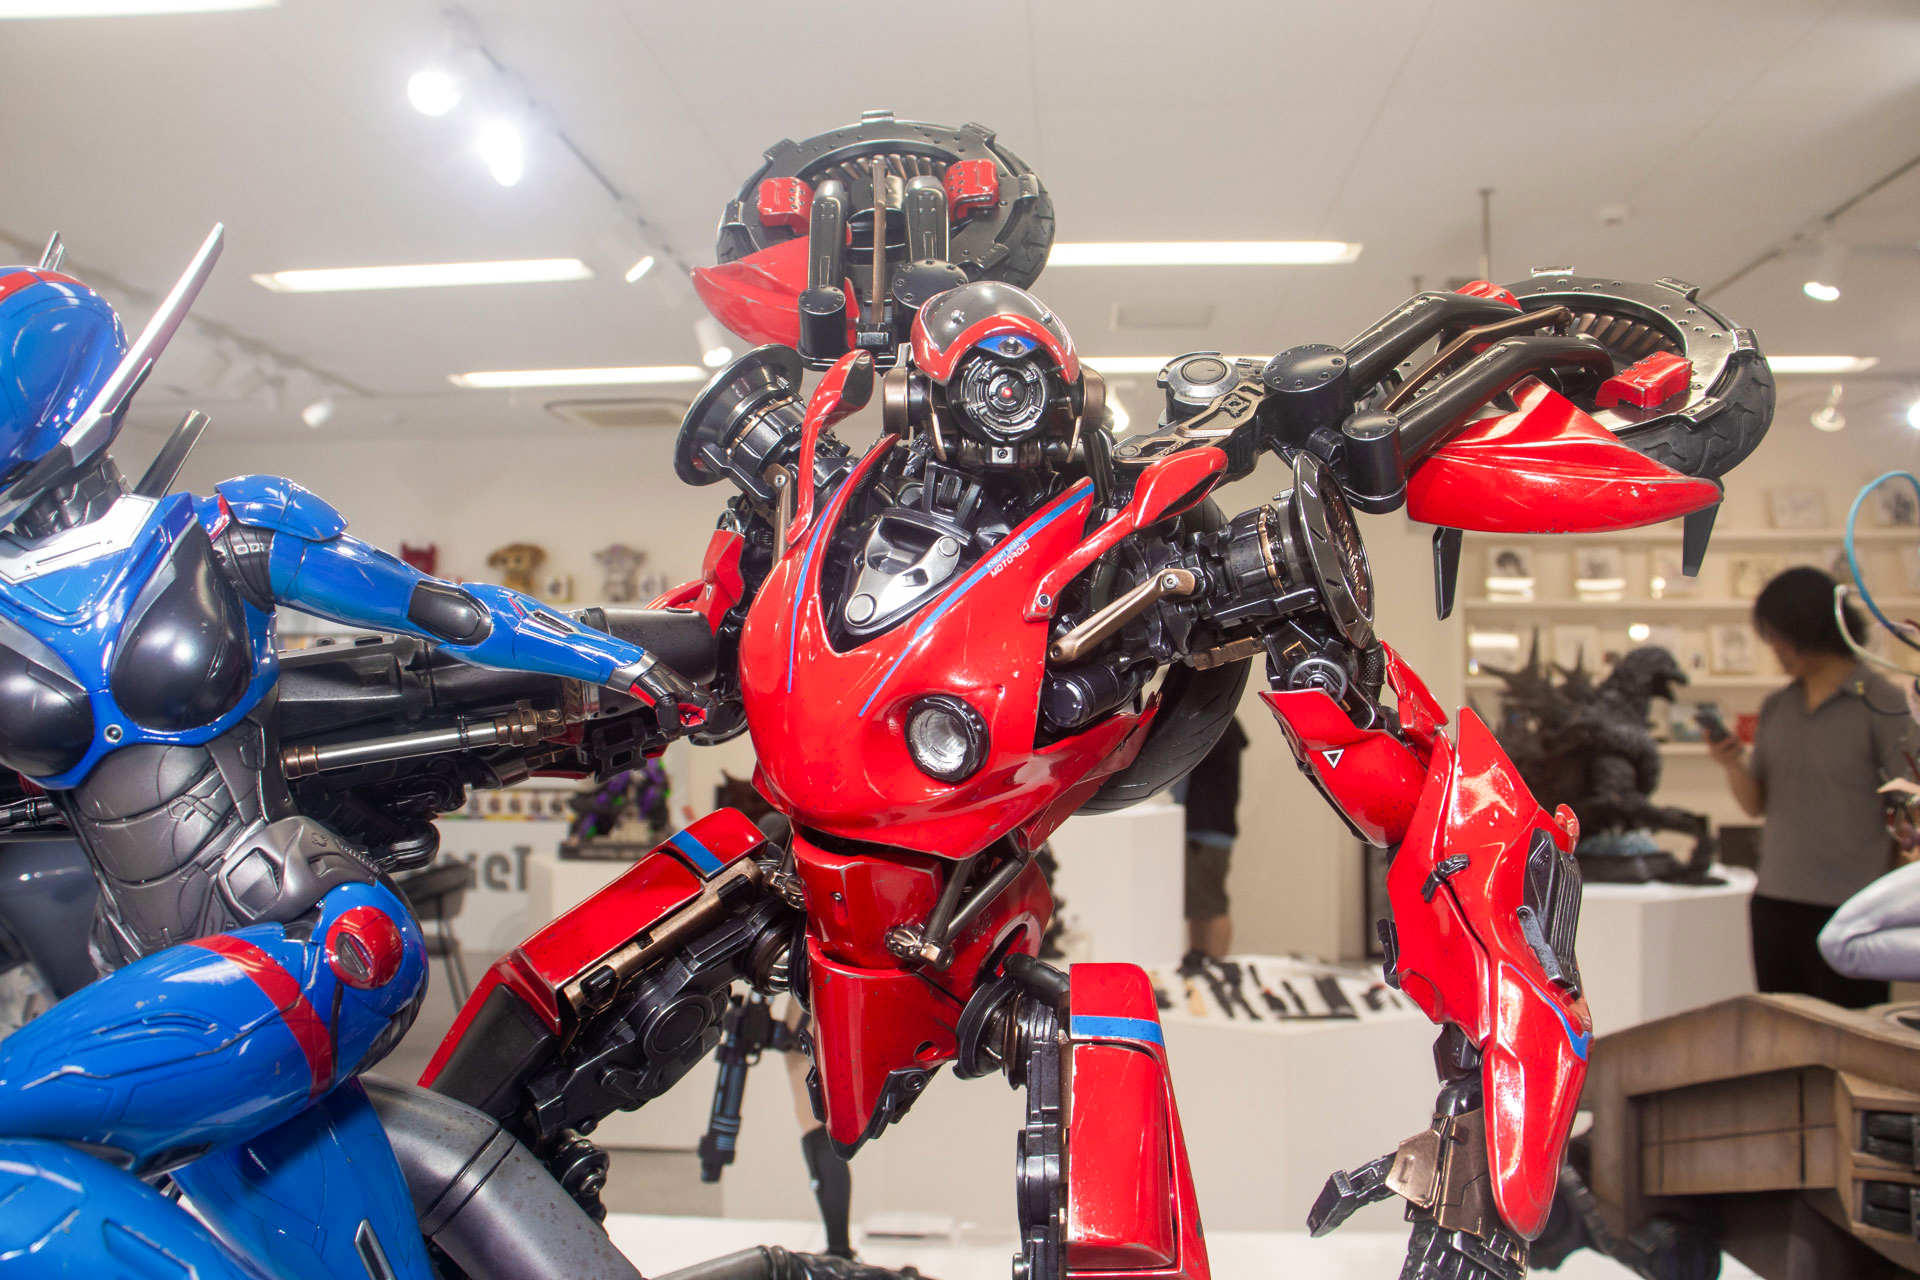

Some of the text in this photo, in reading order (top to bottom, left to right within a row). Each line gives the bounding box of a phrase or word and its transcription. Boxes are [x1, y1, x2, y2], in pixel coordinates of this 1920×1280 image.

[986, 534, 1026, 569] KNIGHT SABERS
[990, 542, 1030, 578] MOTOROID
